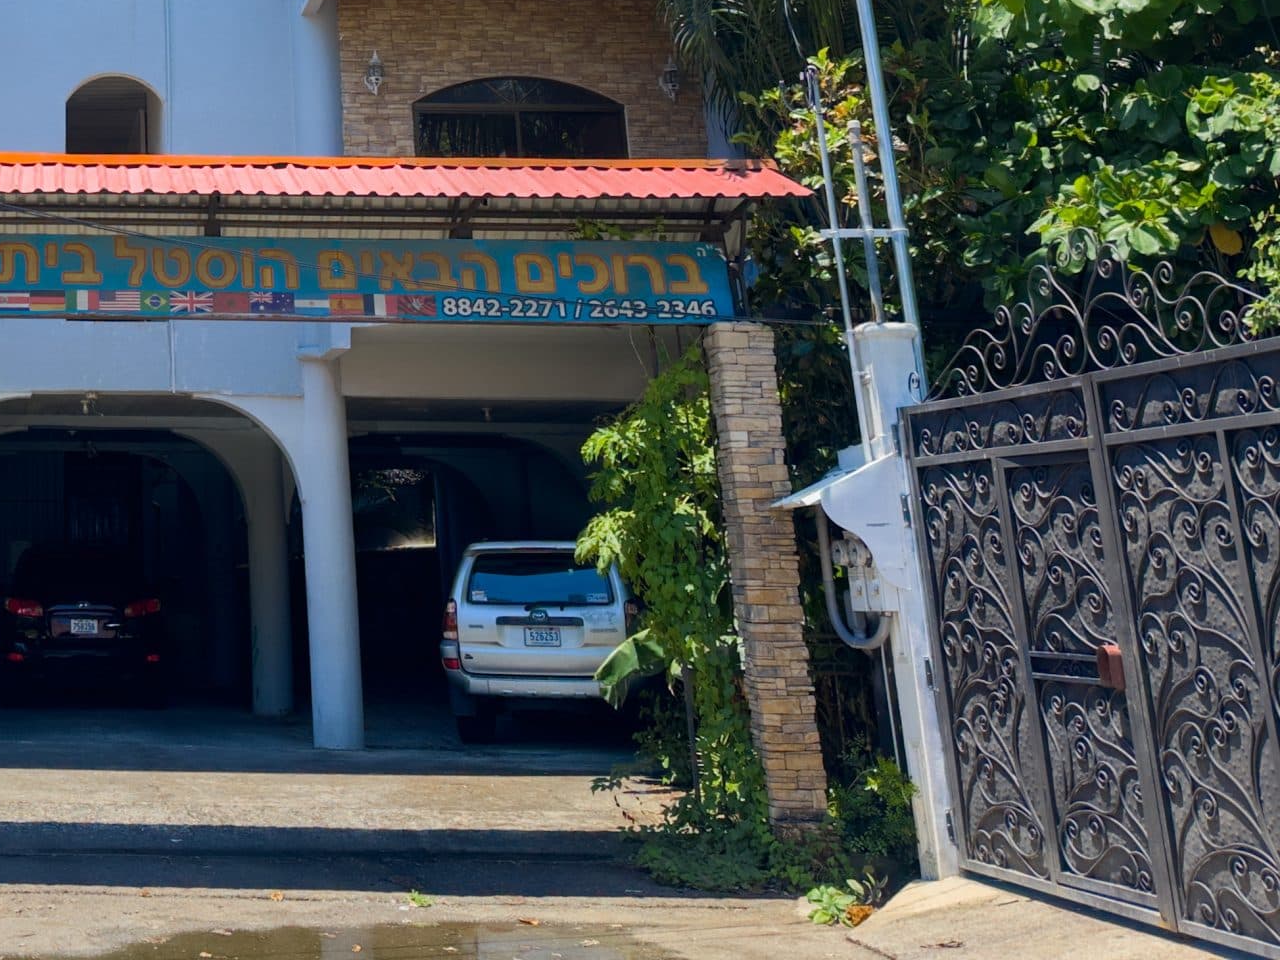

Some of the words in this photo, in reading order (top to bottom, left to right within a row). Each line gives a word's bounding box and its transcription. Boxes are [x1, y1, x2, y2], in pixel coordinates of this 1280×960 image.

[113, 235, 300, 290] הוסטל
[317, 248, 501, 294] הבאים
[514, 252, 709, 295] ברוכים
[442, 297, 566, 317] 8842-2271
